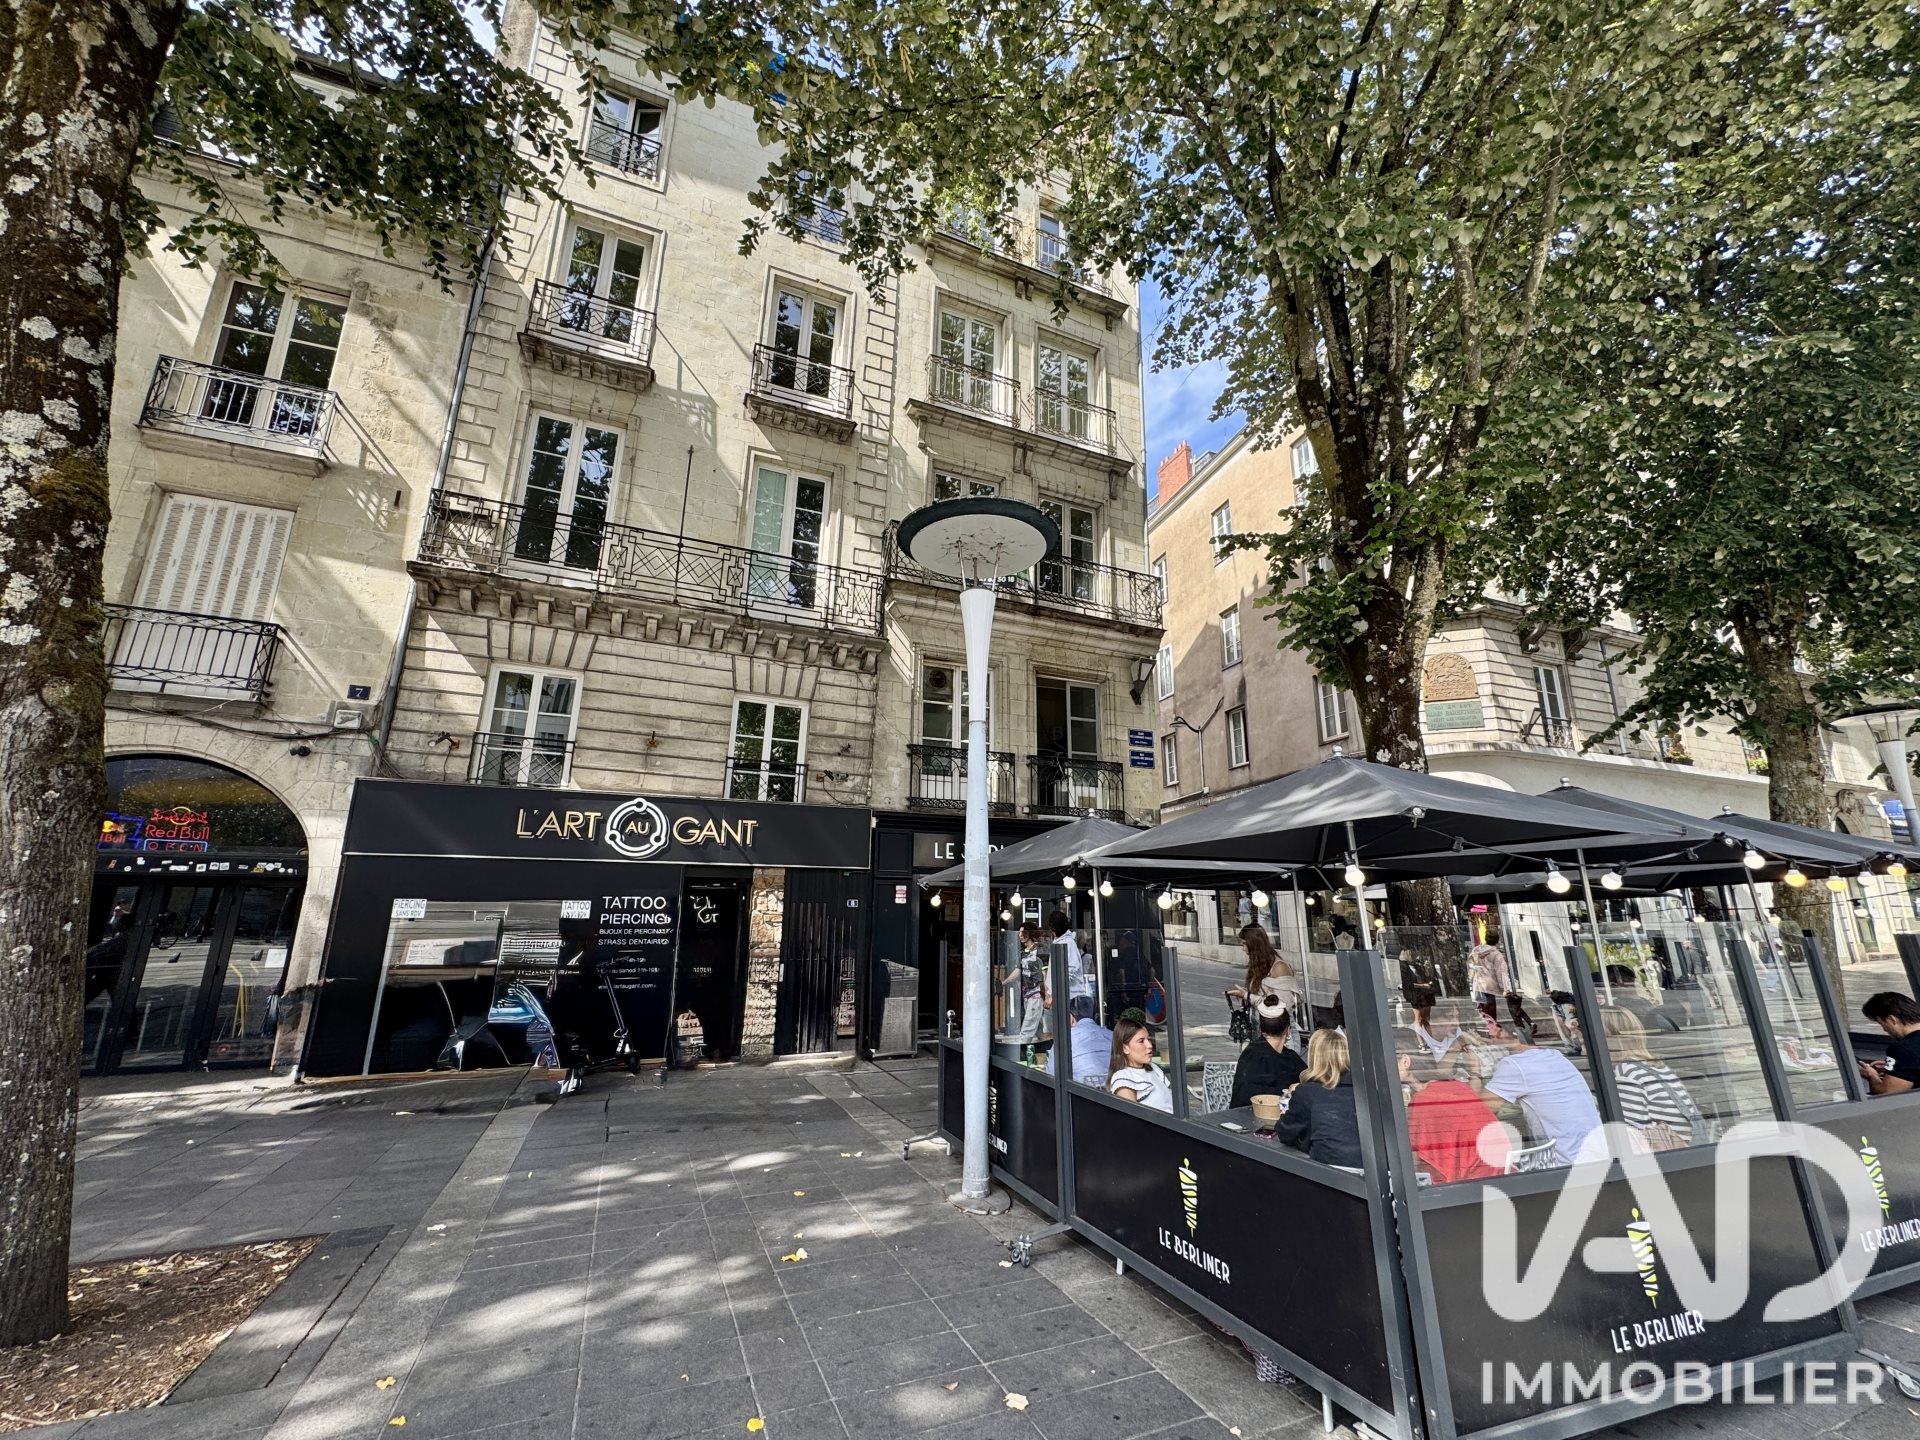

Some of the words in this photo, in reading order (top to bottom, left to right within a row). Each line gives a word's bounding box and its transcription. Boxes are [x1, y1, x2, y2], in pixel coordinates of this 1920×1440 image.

[355, 687, 364, 697] 7
[145, 825, 177, 838] Red
[180, 827, 210, 840] Bull
[516, 808, 603, 841] L'ART
[625, 820, 650, 834] AU
[672, 815, 758, 846] GANT
[148, 842, 204, 852] OPEN
[934, 842, 955, 859] LE
[394, 900, 426, 909] PIERCING
[564, 901, 590, 910] TATTOO
[602, 896, 667, 909] TATTOO
[600, 913, 669, 924] PIERCING
[598, 938, 627, 946] STRASS
[1860, 1231, 1876, 1252] LE
[1159, 1226, 1172, 1250] LE
[1174, 1234, 1230, 1285] BERLINER
[1611, 1326, 1632, 1353] LE
[1632, 1309, 1706, 1348] BERLINER
